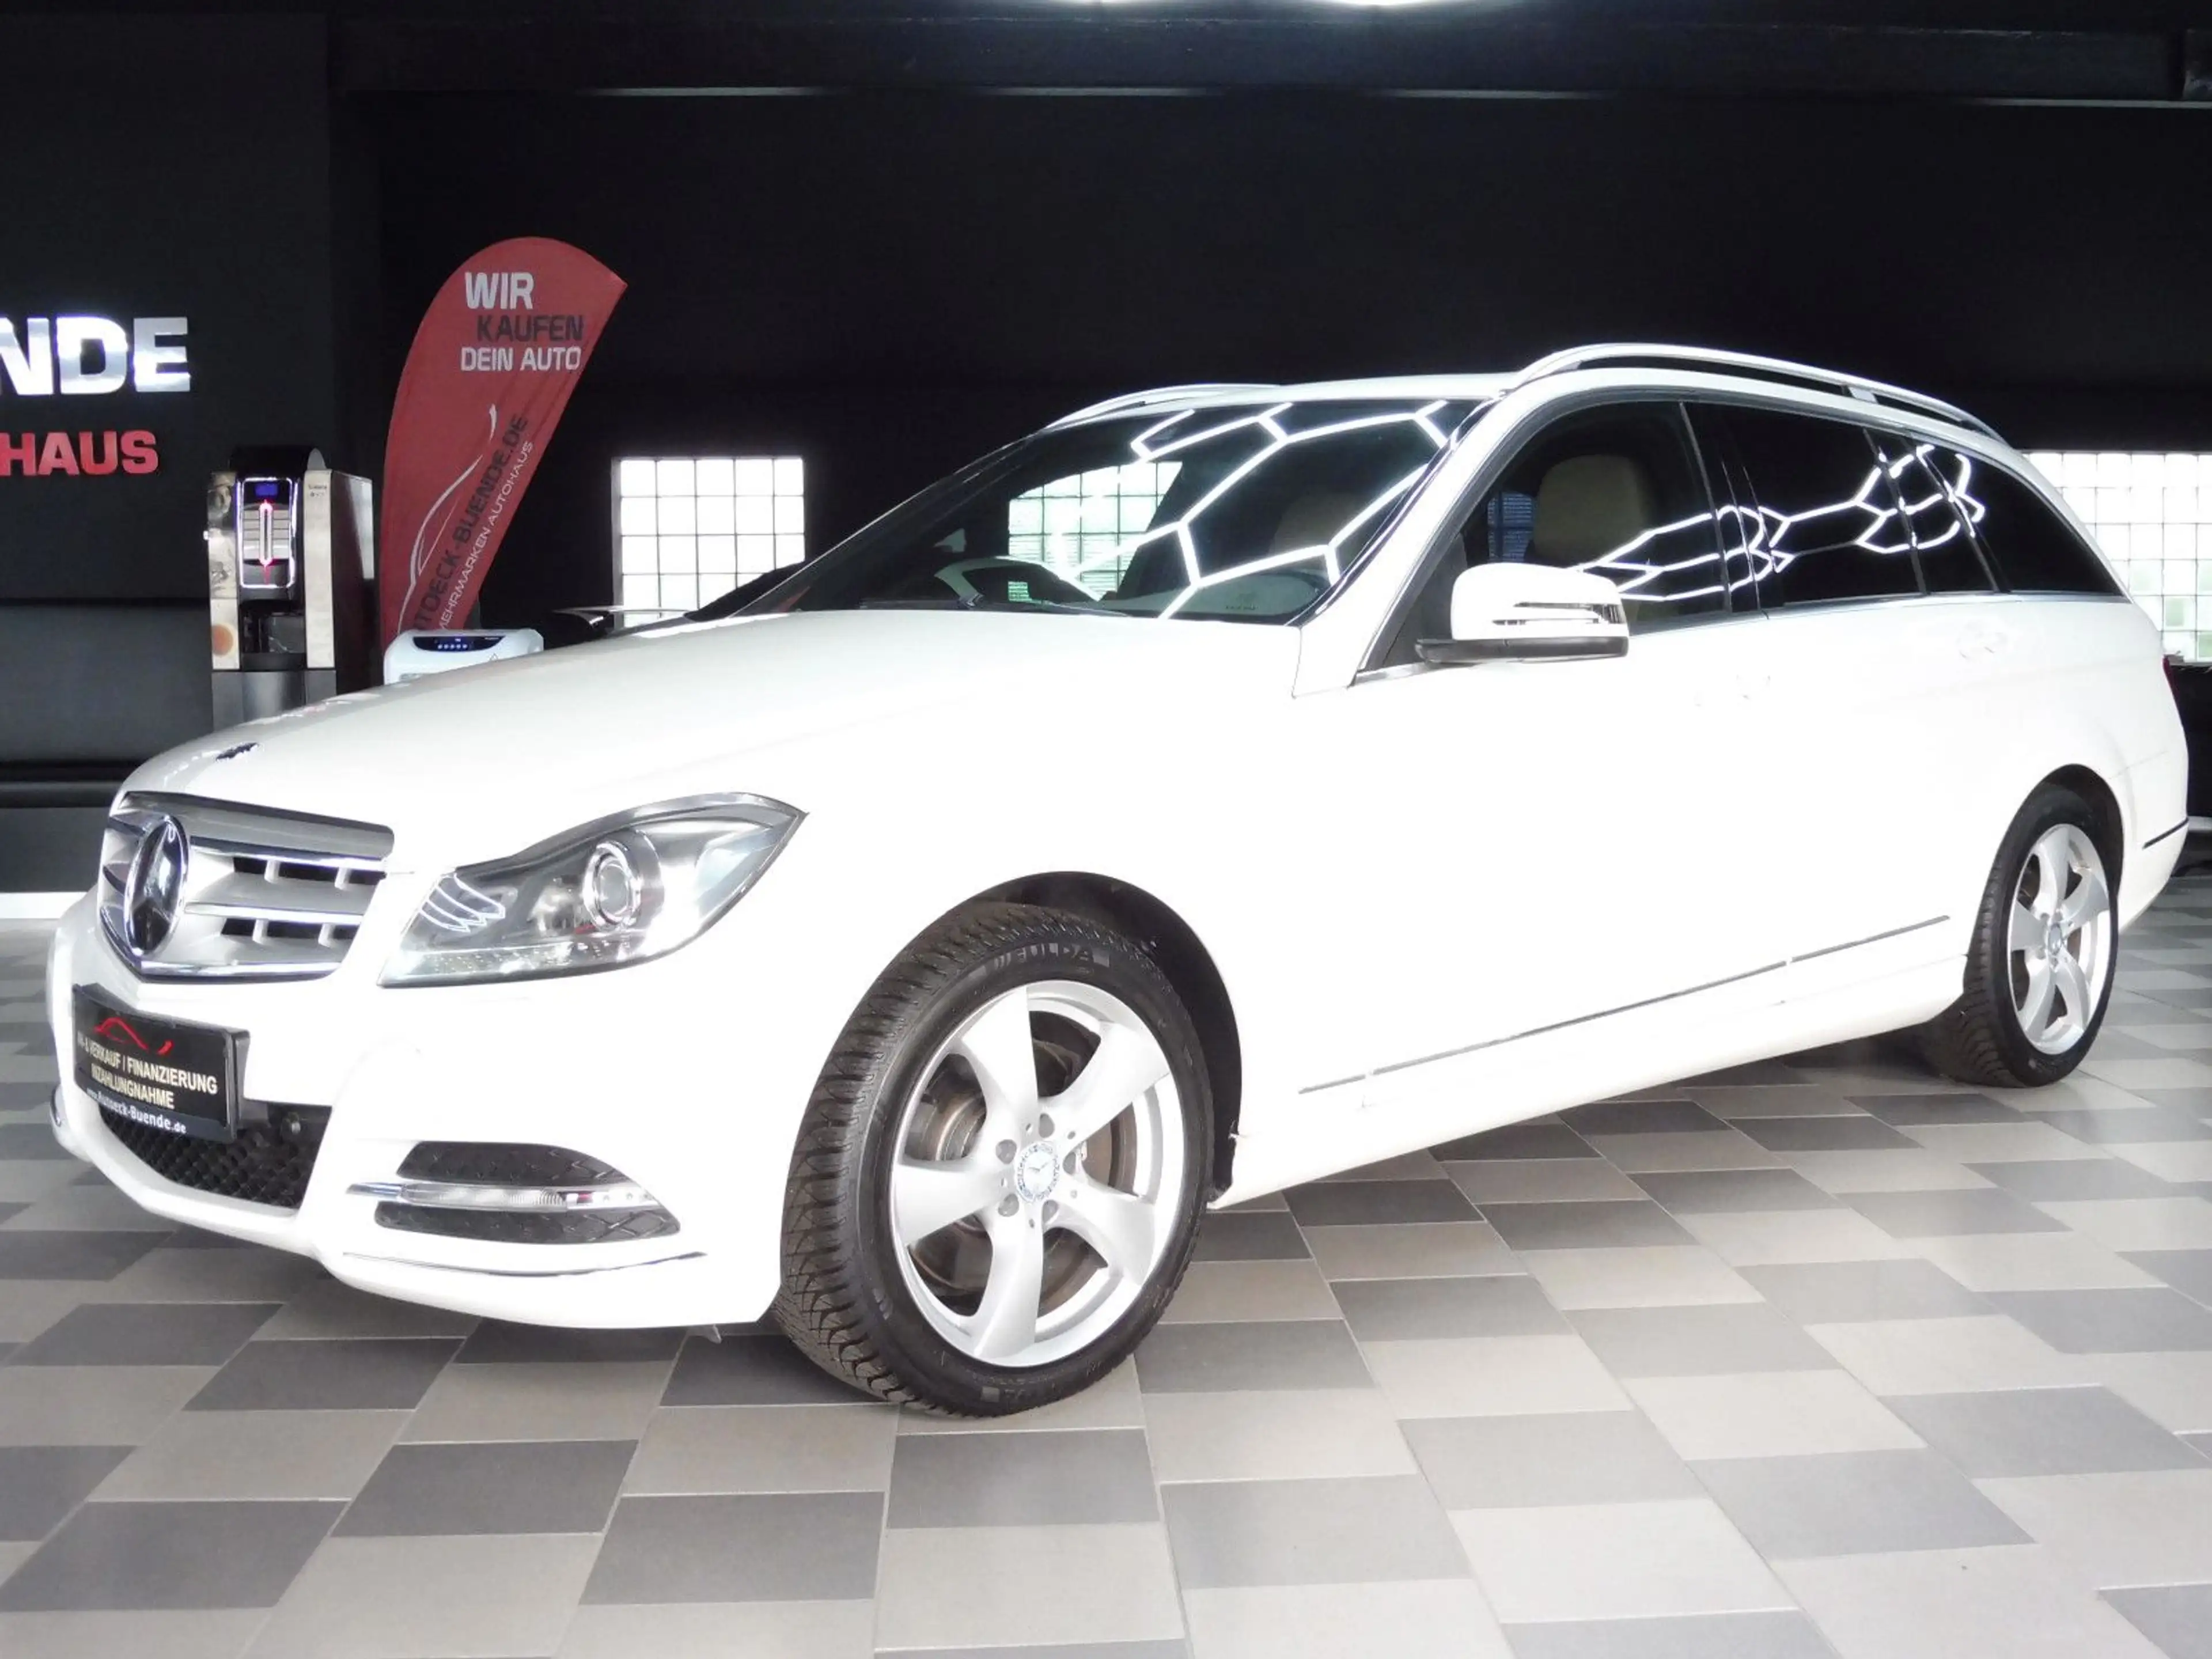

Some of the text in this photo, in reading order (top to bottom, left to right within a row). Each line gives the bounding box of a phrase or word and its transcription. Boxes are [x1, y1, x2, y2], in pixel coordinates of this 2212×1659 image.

[465, 271, 535, 309] WIR
[477, 315, 583, 342] KAUFEN
[0, 316, 191, 395] NDE
[461, 347, 582, 372] DEIN AUTO
[0, 431, 158, 476] HAUS
[490, 441, 533, 527] AUTOHAUS
[412, 412, 528, 630] TOECK-BUENDE.DE
[127, 1055, 218, 1094] FINANZIERUNG
